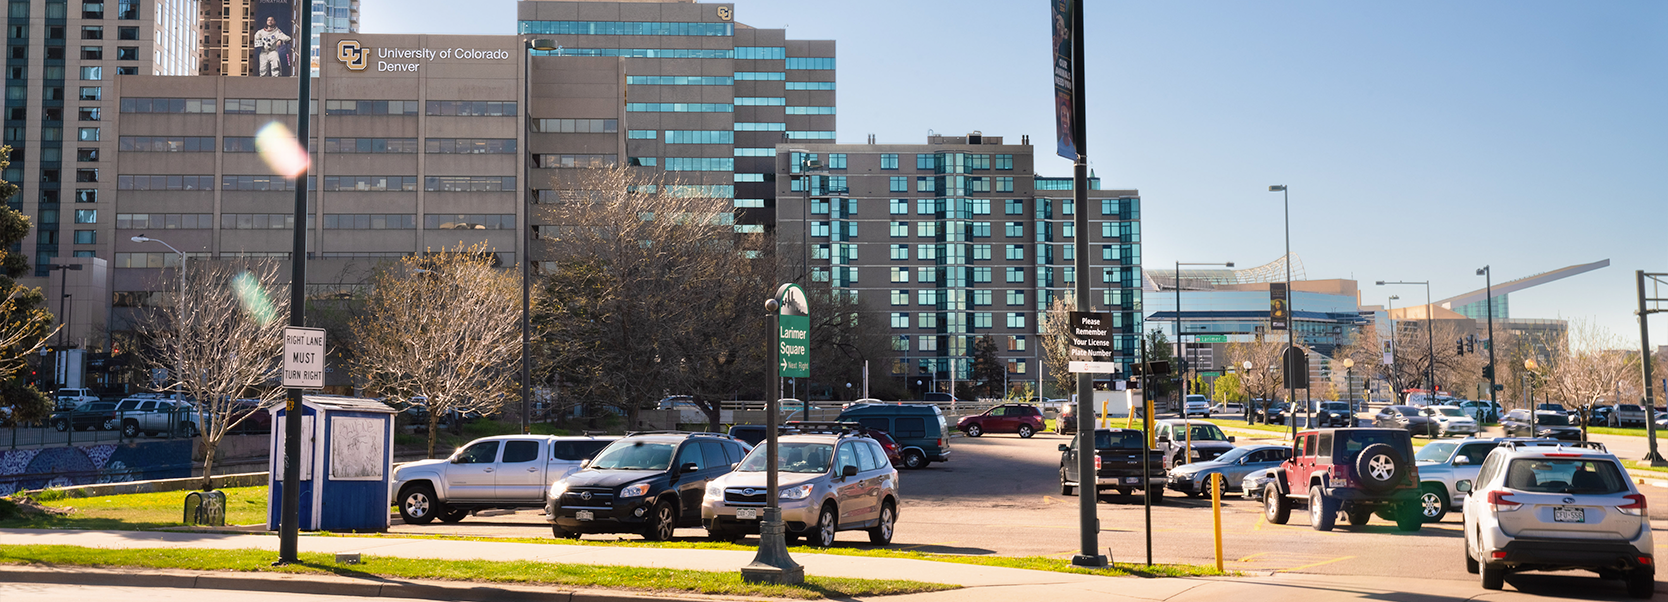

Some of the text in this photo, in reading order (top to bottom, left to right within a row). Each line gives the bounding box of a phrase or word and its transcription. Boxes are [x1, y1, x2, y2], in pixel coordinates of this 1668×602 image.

[378, 48, 509, 61] University of Colorado
[378, 61, 420, 72] Denver
[1081, 317, 1101, 326] Please
[780, 325, 807, 340] Larimer
[1075, 328, 1107, 336] Remember
[286, 335, 322, 346] RIGHT LANE
[1073, 338, 1087, 346] Your
[780, 341, 805, 357] Square
[1087, 349, 1112, 357] Number
[292, 352, 315, 364] MUST
[788, 361, 809, 371] Next Right
[285, 370, 301, 379] TURN
[303, 371, 322, 380] RIGHT
